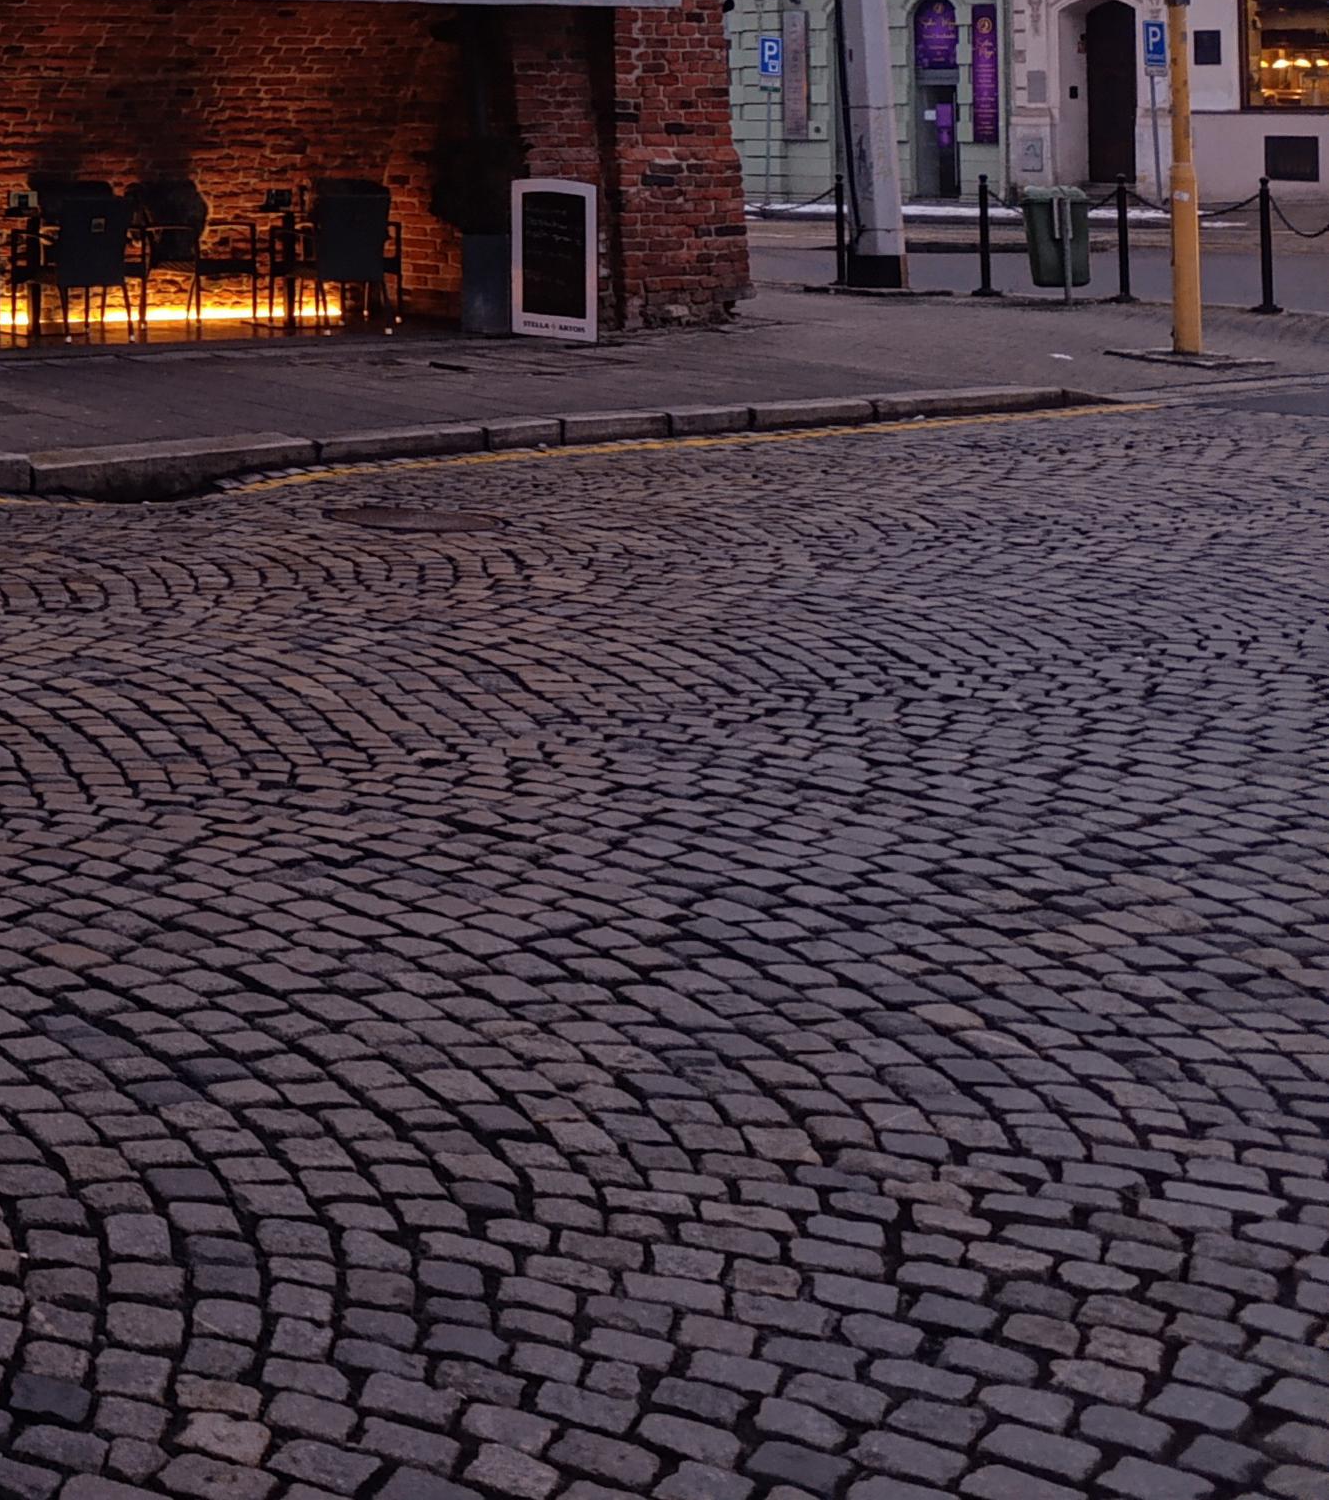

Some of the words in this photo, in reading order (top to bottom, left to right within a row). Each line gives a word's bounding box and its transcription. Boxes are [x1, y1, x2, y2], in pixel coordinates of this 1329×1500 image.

[1148, 26, 1161, 51] P
[764, 41, 777, 63] P
[523, 320, 549, 329] STELLA
[558, 323, 585, 333] ARTOIS
